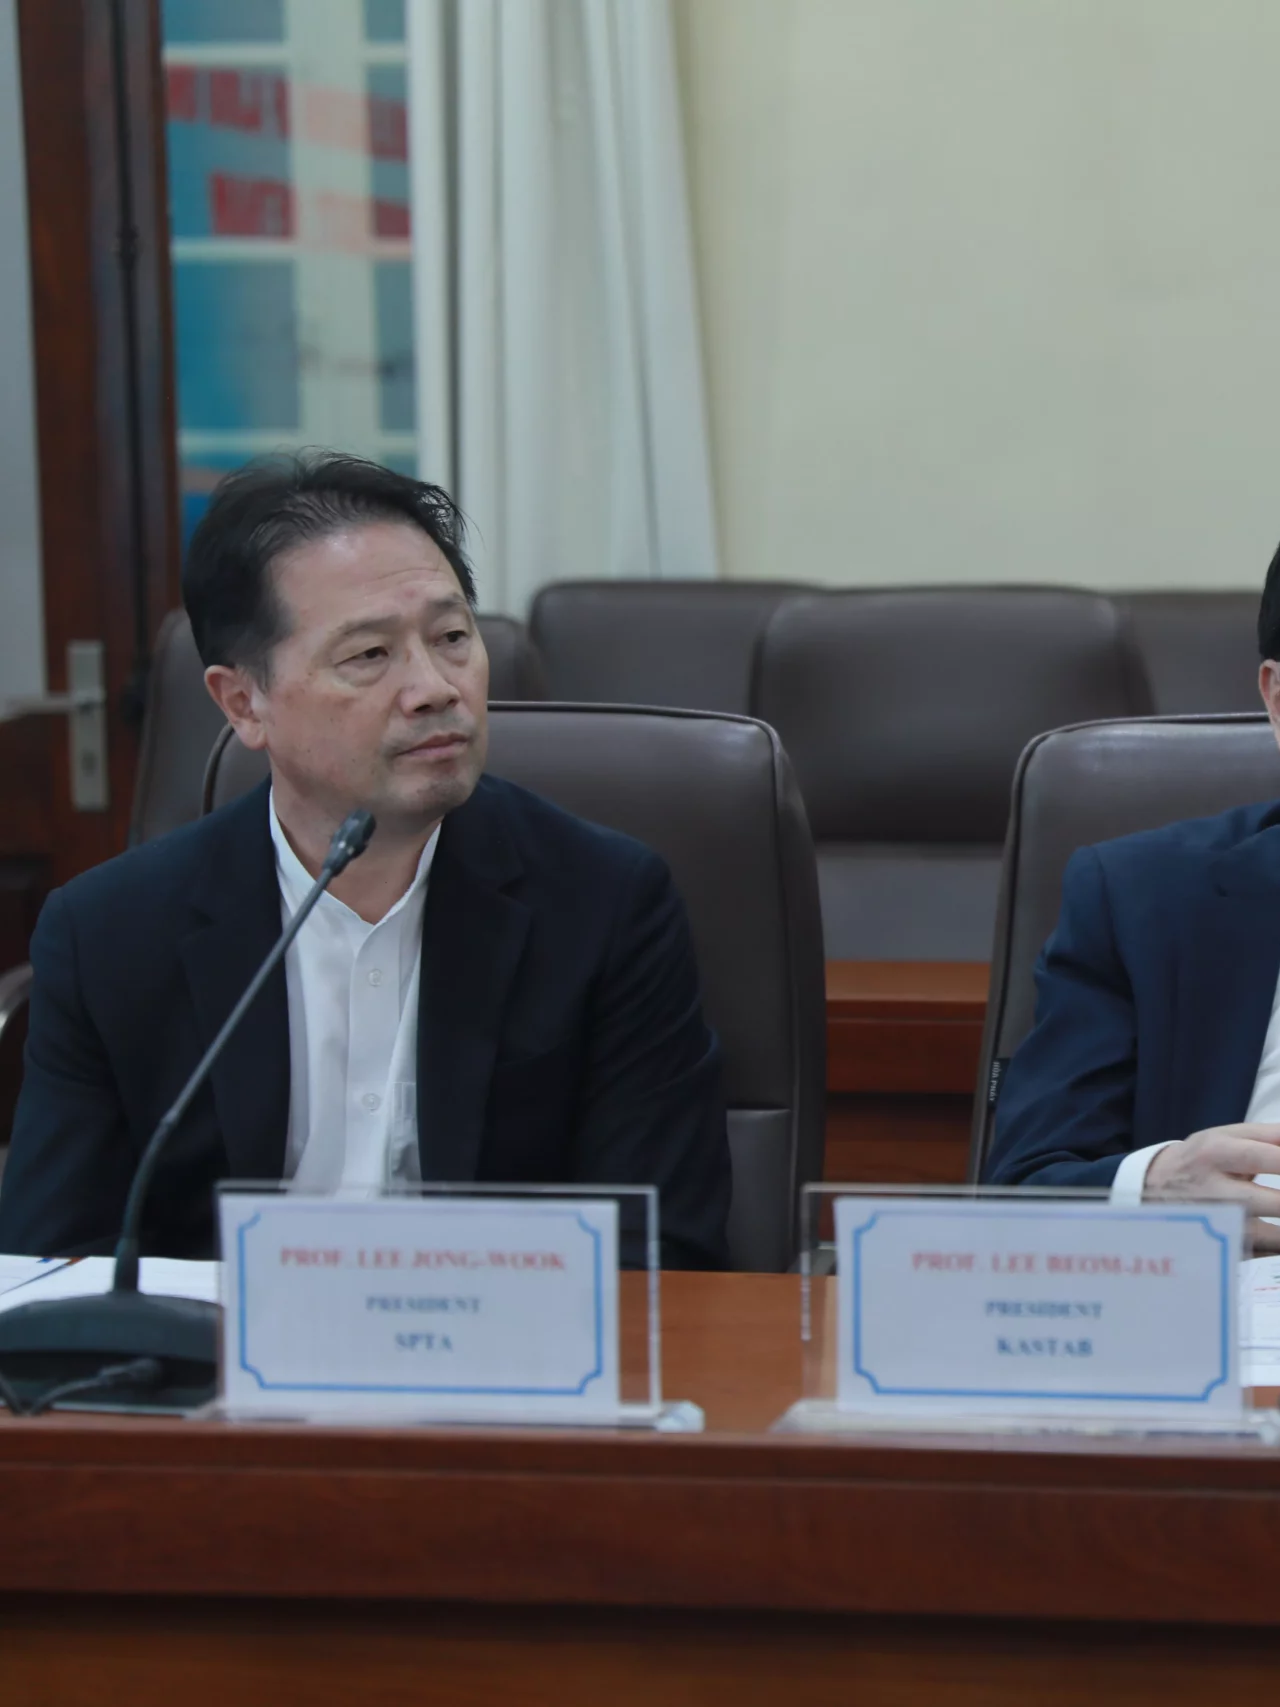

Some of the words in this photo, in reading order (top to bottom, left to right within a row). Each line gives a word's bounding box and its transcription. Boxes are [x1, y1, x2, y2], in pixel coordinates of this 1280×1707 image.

[357, 1247, 402, 1269] LEE
[992, 1253, 1037, 1275] LEE
[366, 1295, 481, 1314] PRESIDENT
[985, 1300, 1103, 1320] PRESIDENT
